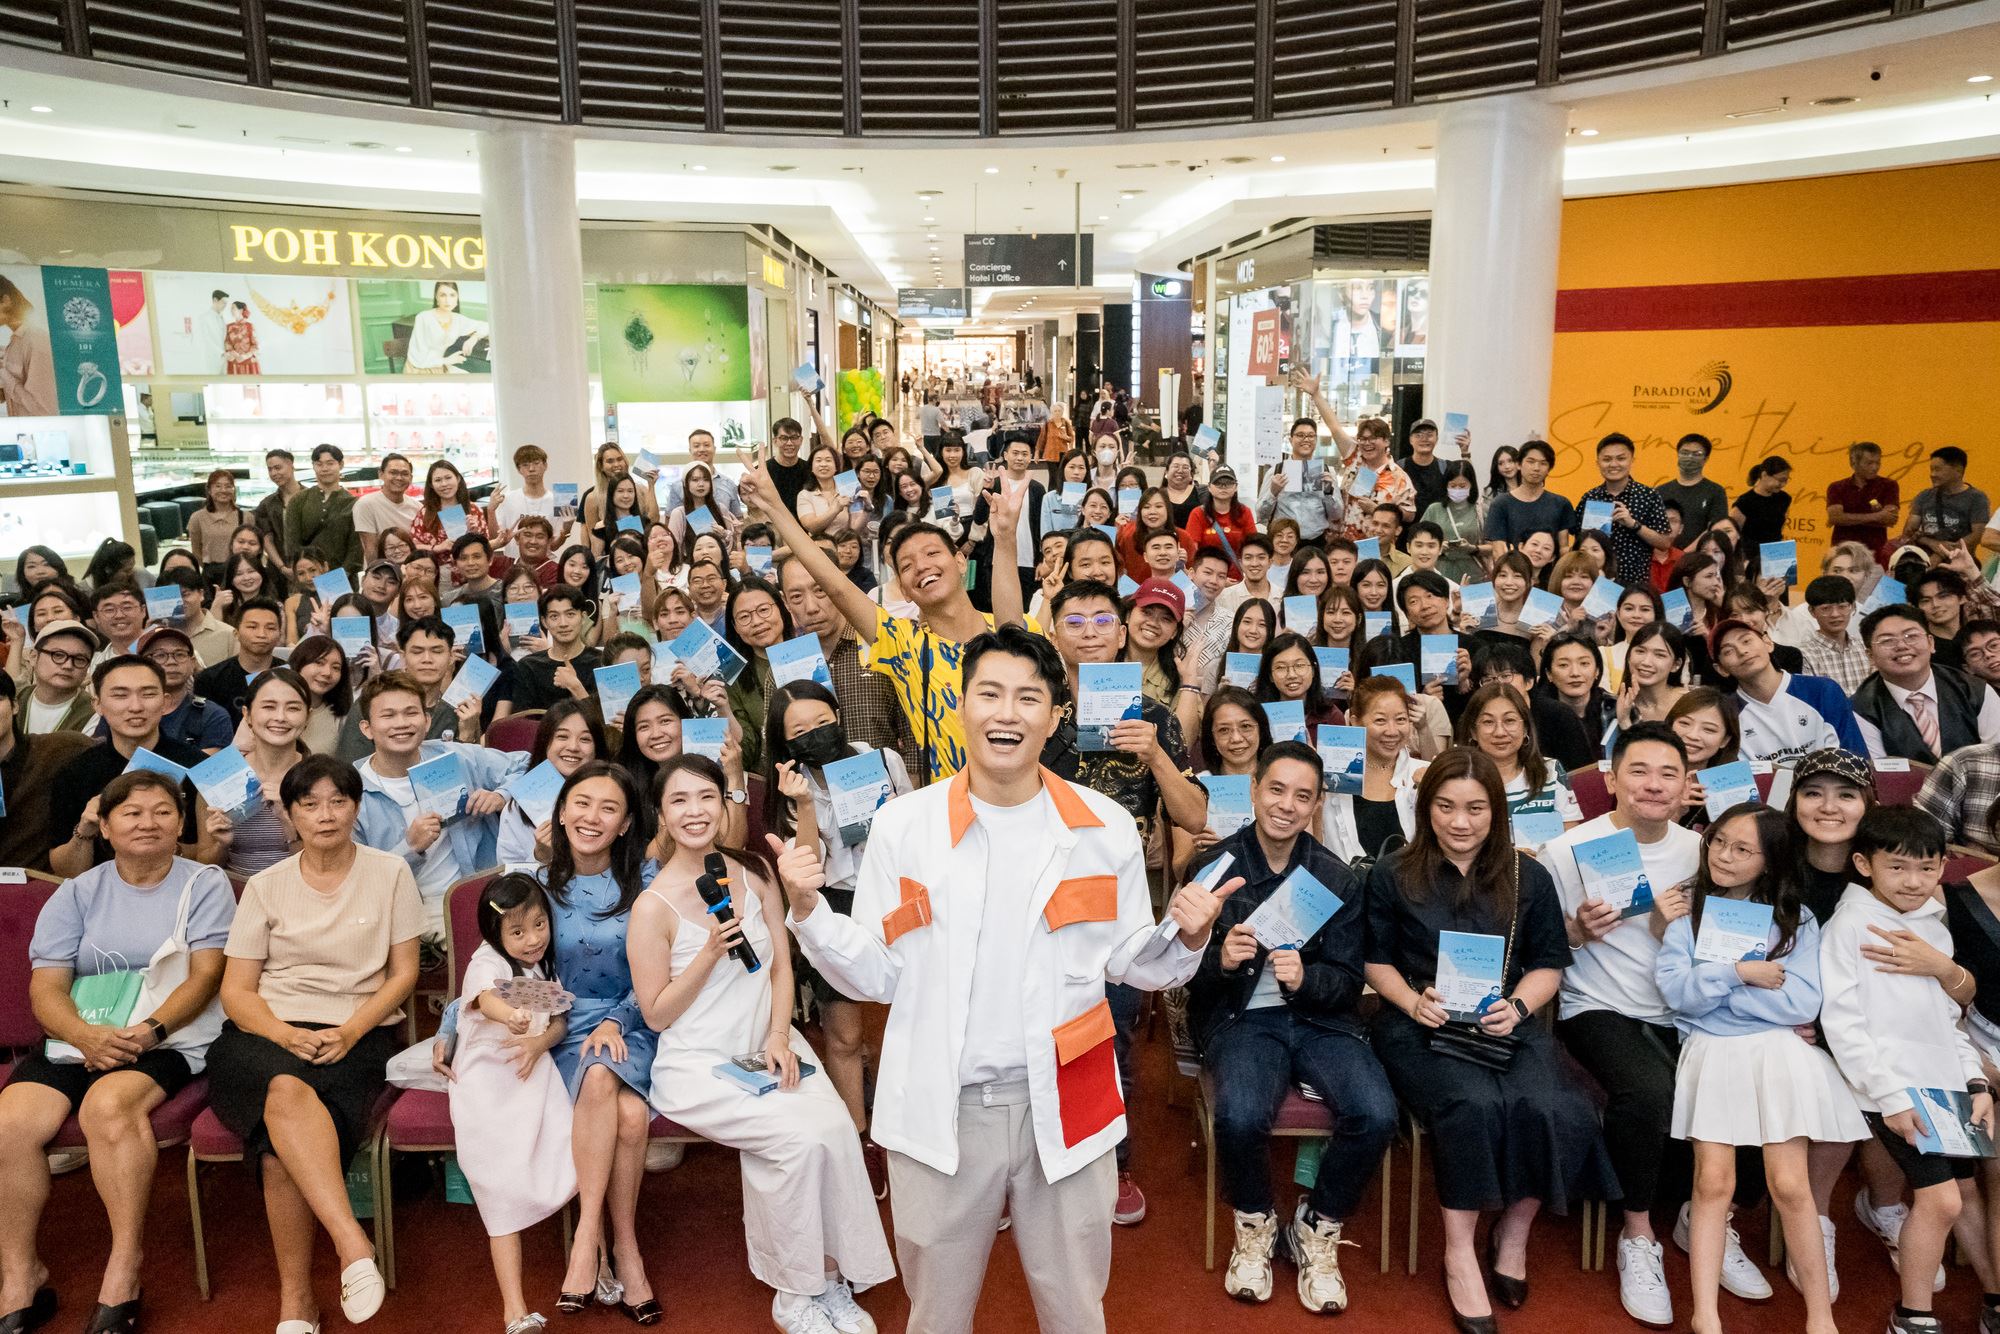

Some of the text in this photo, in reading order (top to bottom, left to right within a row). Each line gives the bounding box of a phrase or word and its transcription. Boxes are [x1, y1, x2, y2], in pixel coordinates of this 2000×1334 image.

[982, 238, 996, 246] CC
[230, 225, 485, 270] POH KONG
[969, 263, 1012, 272] Concierge
[54, 278, 101, 288] HEMERA
[1633, 385, 1711, 397] PARADIGM
